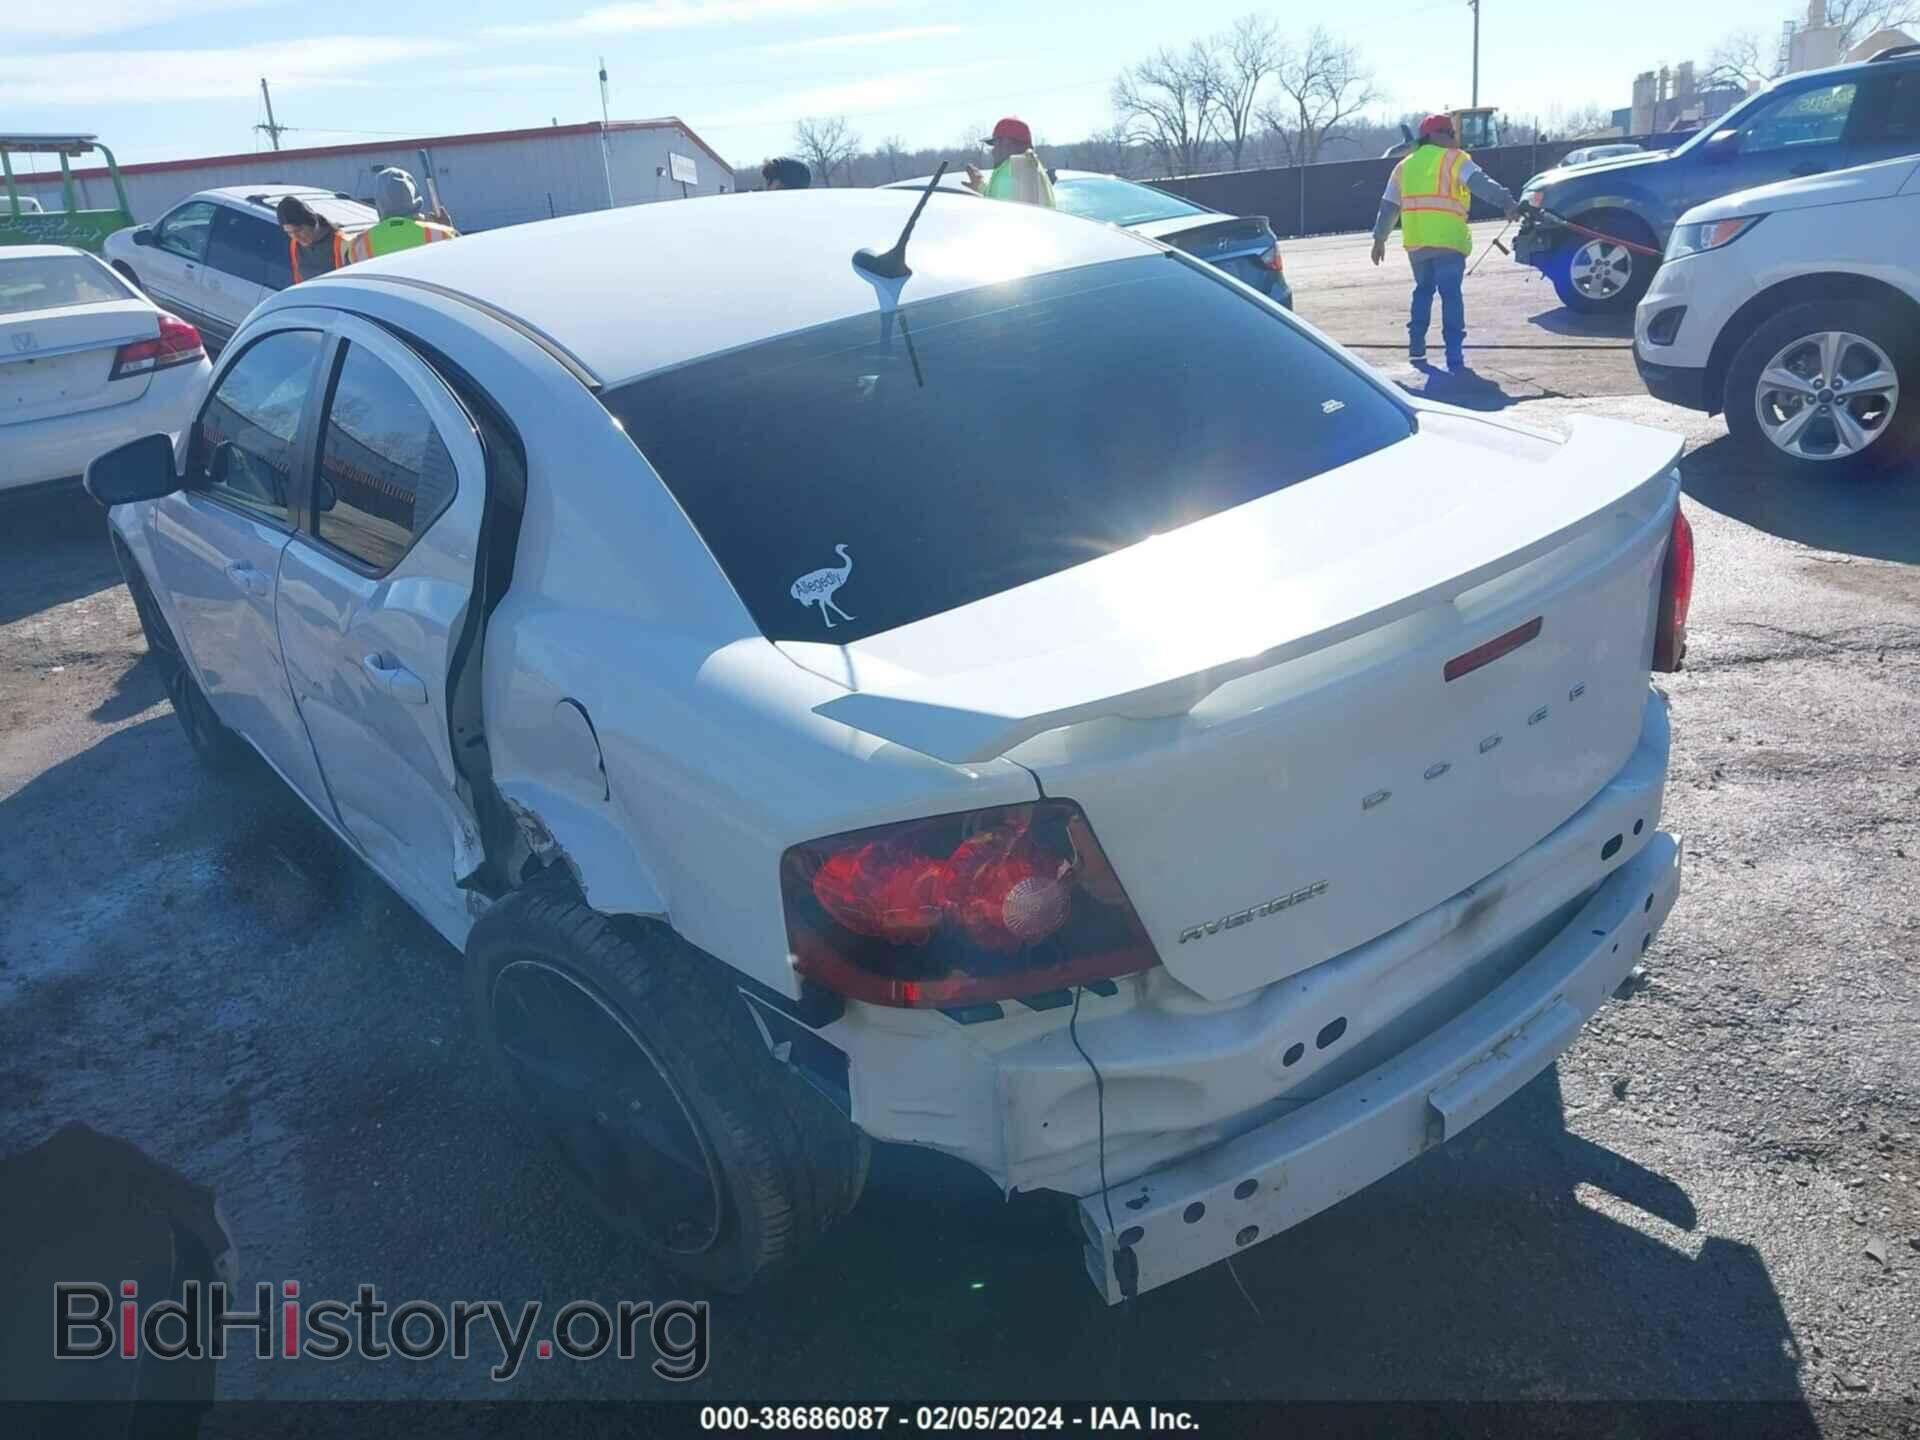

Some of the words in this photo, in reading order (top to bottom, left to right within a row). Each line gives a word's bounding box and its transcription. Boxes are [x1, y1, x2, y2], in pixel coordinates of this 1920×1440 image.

[795, 571, 846, 597] Allegedly
[1361, 680, 1585, 811] DODGE
[1178, 879, 1329, 945] AVENGER
